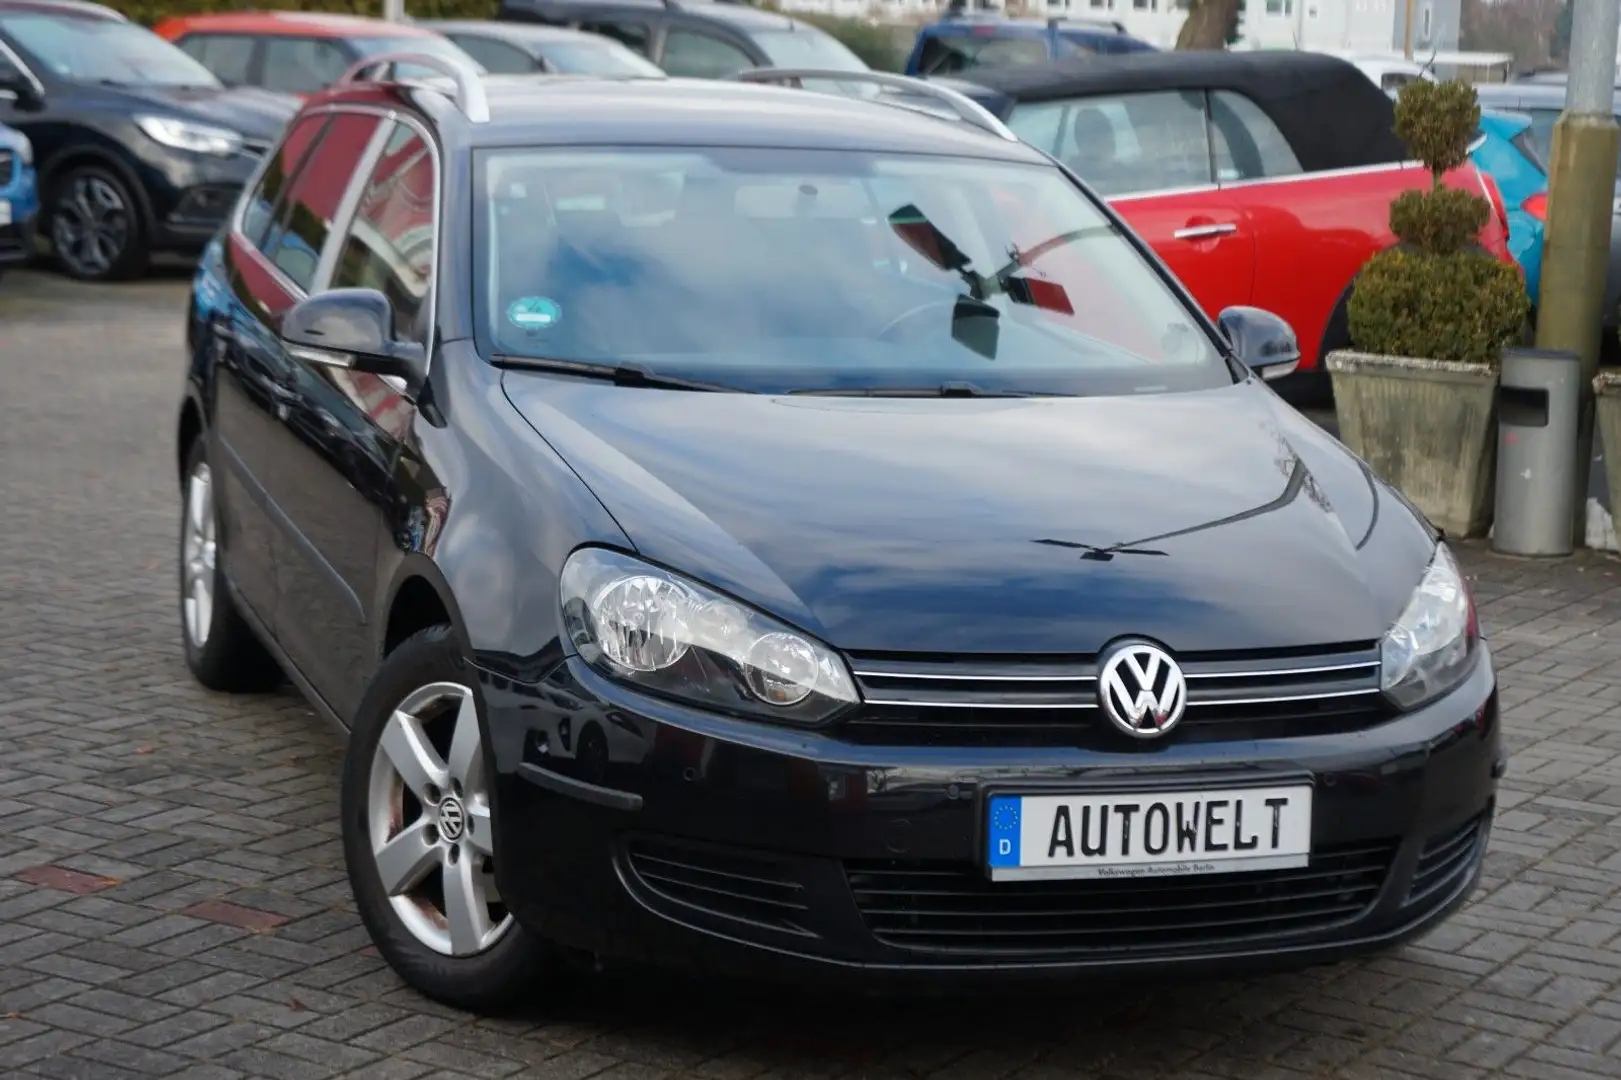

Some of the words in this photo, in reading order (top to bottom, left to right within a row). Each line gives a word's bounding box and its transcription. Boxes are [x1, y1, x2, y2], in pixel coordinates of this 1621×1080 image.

[1101, 645, 1186, 737] VW
[999, 839, 1011, 855] D
[1048, 797, 1289, 858] AUTOWELT
